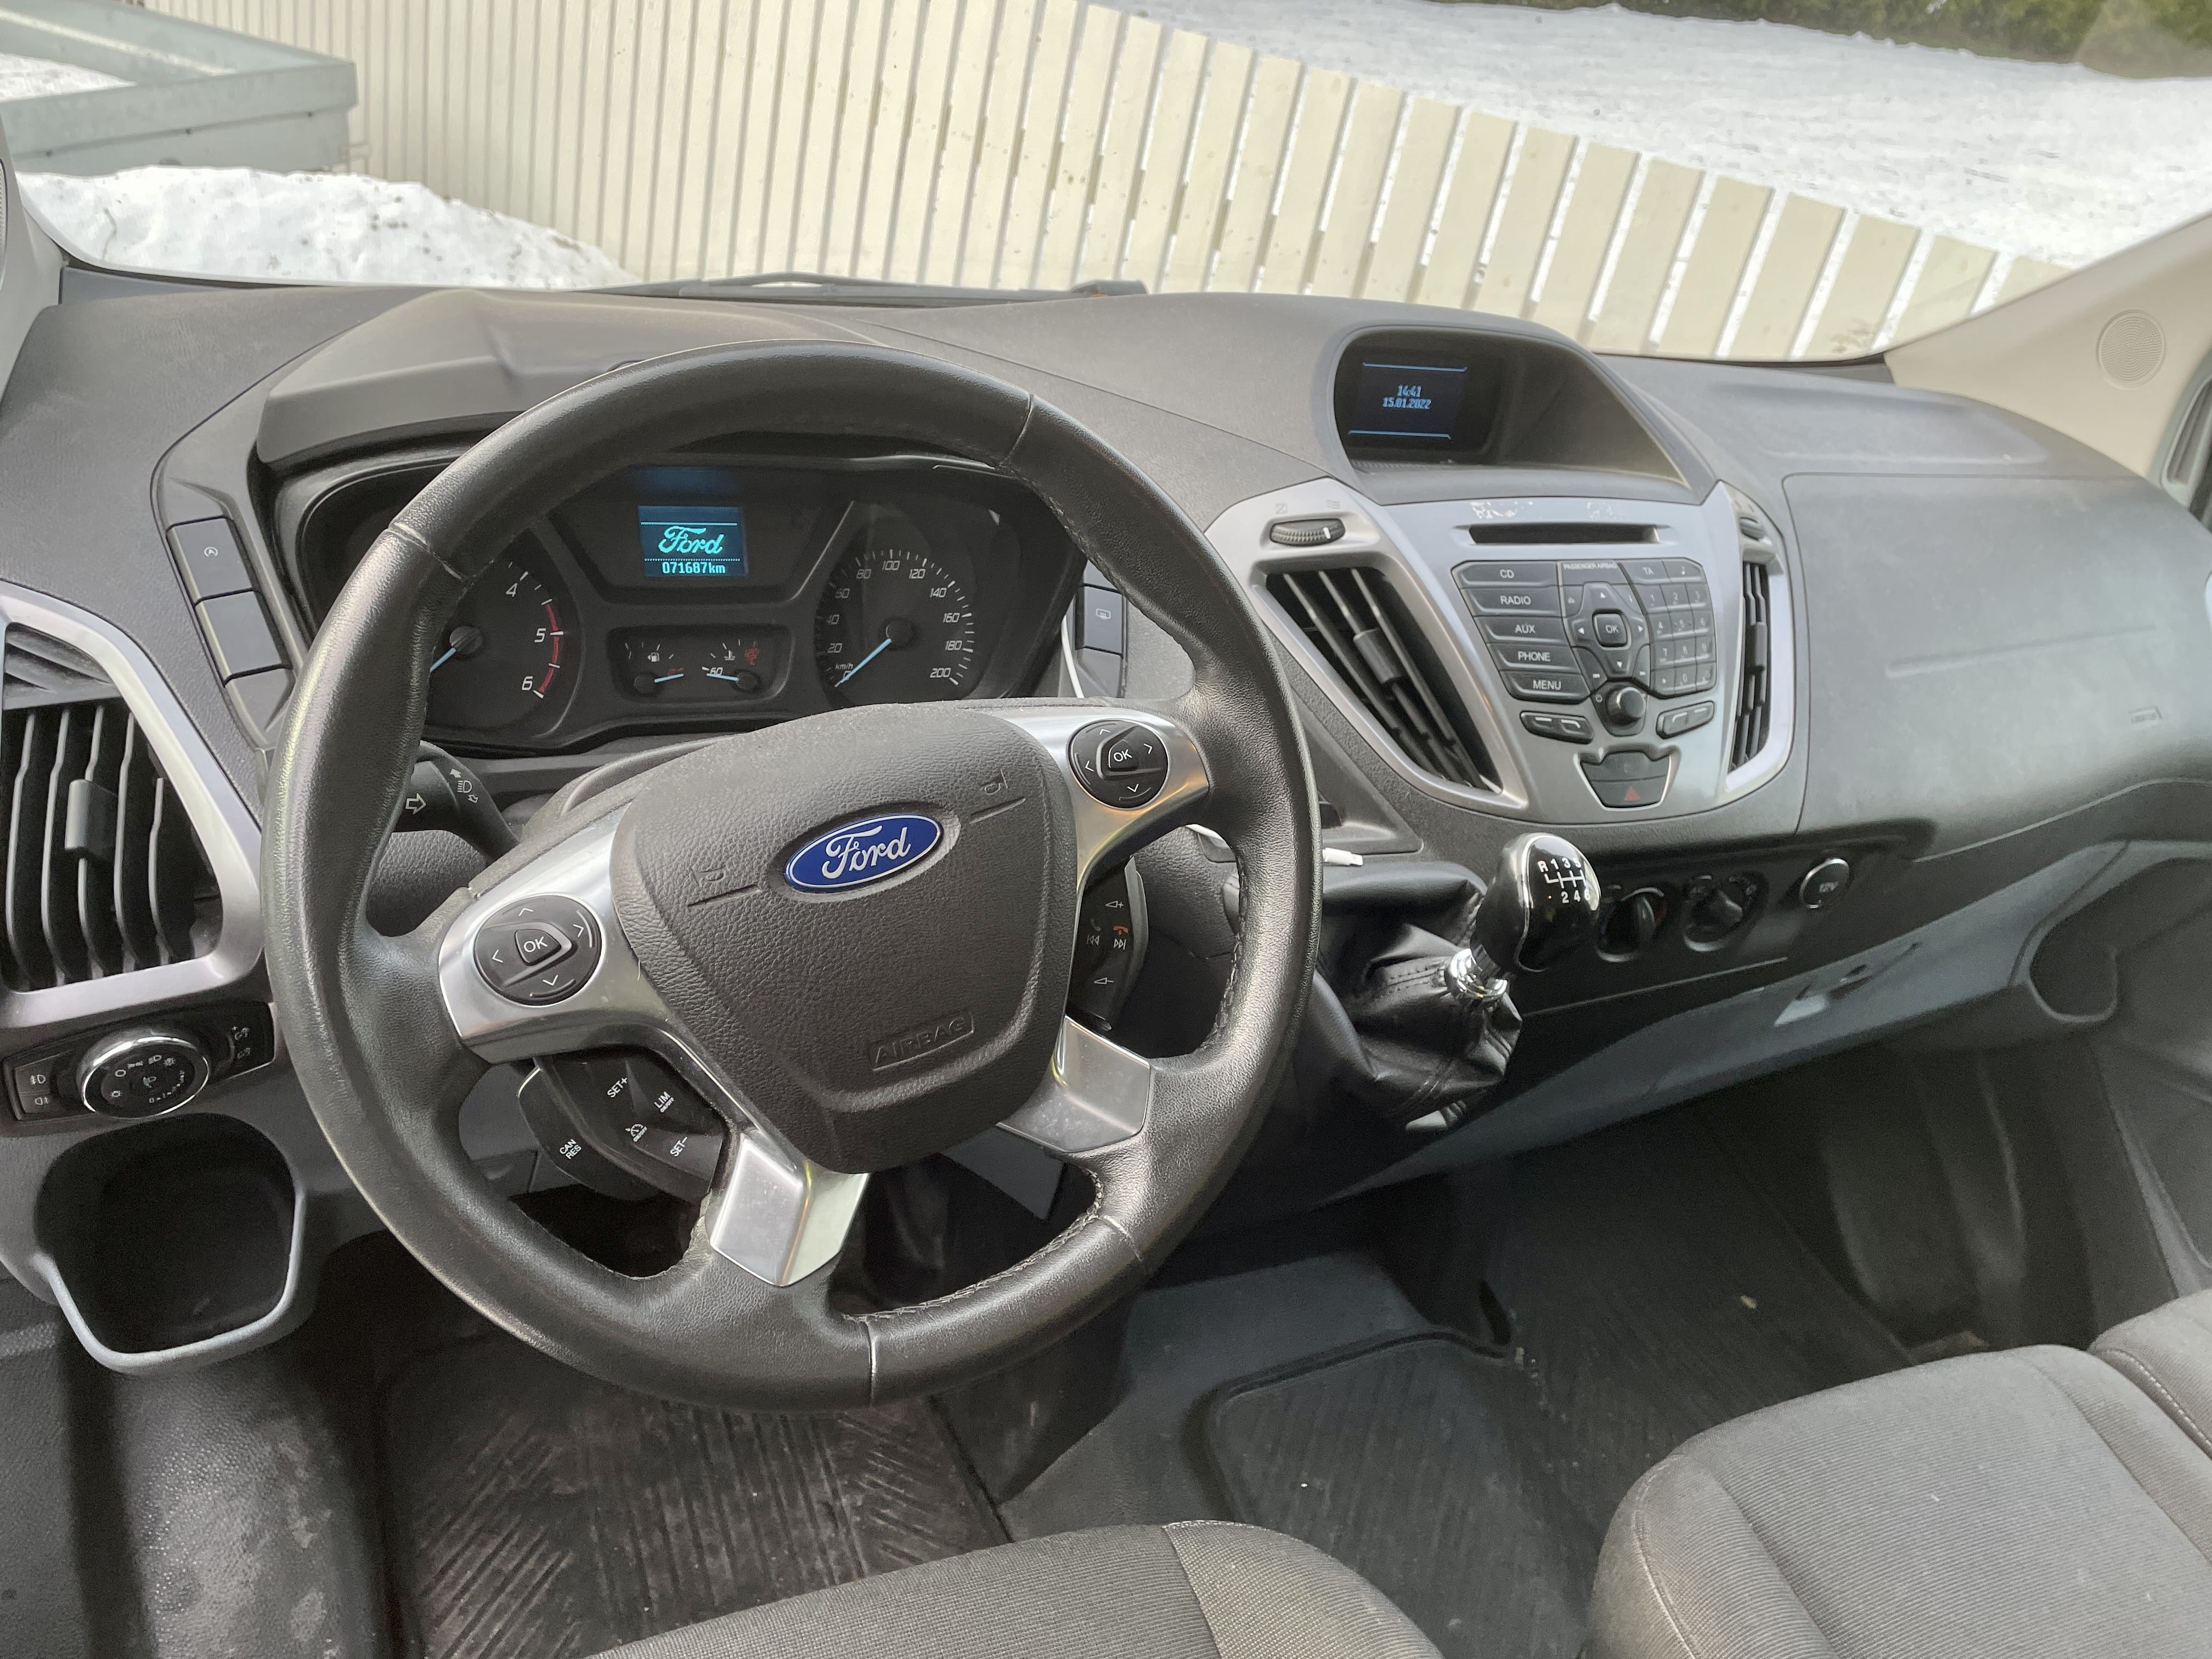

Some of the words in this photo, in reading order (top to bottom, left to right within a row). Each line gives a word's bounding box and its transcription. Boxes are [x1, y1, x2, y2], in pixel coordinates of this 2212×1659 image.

[1383, 397, 1431, 409] 15.01.2022
[658, 526, 724, 554] Ford
[882, 560, 900, 571] 100
[856, 569, 871, 579] 80
[909, 569, 926, 579] 120
[1500, 569, 1514, 579] CD
[506, 583, 518, 597] 4
[836, 588, 850, 598] 60
[930, 588, 947, 598] 140
[1500, 595, 1531, 605] RADIO
[943, 613, 960, 623] 160
[1515, 624, 1536, 634] AUX
[1605, 624, 1619, 634] OK
[534, 628, 546, 642] 5
[828, 643, 842, 653] 20
[945, 640, 962, 651] 180
[1518, 651, 1551, 662] PHONE
[710, 667, 723, 675] 60
[930, 668, 951, 678] 200
[522, 676, 533, 690] 6
[1533, 680, 1561, 690] MENU
[1113, 749, 1132, 763] OK
[822, 825, 911, 879] Ford
[1537, 860, 1549, 873] R
[1550, 858, 1559, 870] 1
[1562, 857, 1571, 868] 3
[1561, 891, 1570, 904] 2
[1573, 890, 1581, 902] 4
[1584, 888, 1590, 901] 6
[523, 936, 548, 952] OK
[607, 1077, 627, 1098] SET+
[654, 1091, 670, 1108] LIM
[560, 1139, 577, 1154] CAN
[566, 1144, 582, 1159] RES
